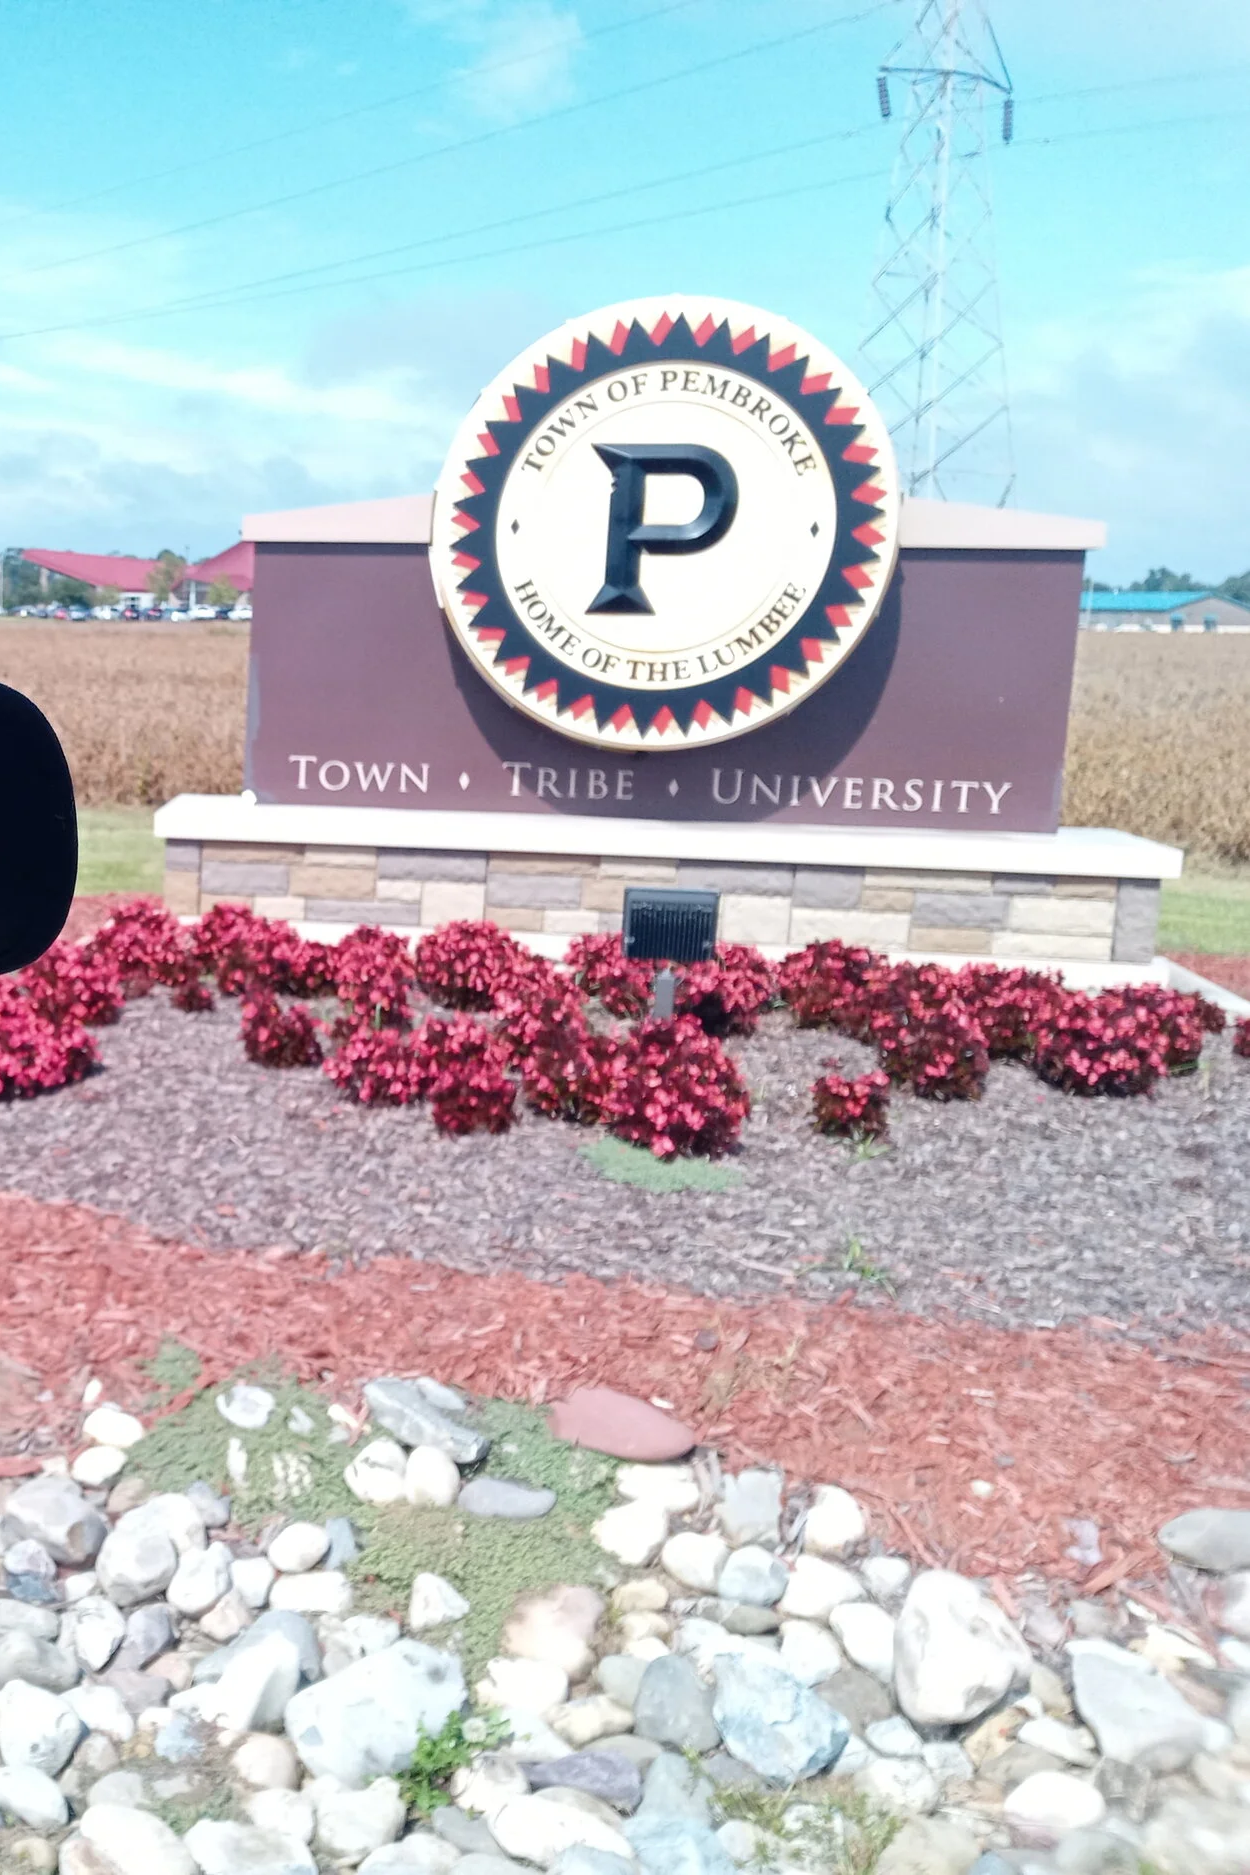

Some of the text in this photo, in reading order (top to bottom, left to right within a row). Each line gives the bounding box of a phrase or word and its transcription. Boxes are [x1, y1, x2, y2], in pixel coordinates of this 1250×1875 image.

[520, 369, 818, 478] TOWN OF PEMBROKE
[585, 442, 740, 616] P
[513, 579, 808, 682] HOME OF THE LUMBEE
[288, 754, 1014, 815] TOWN TRIBE UNIVERSITY
